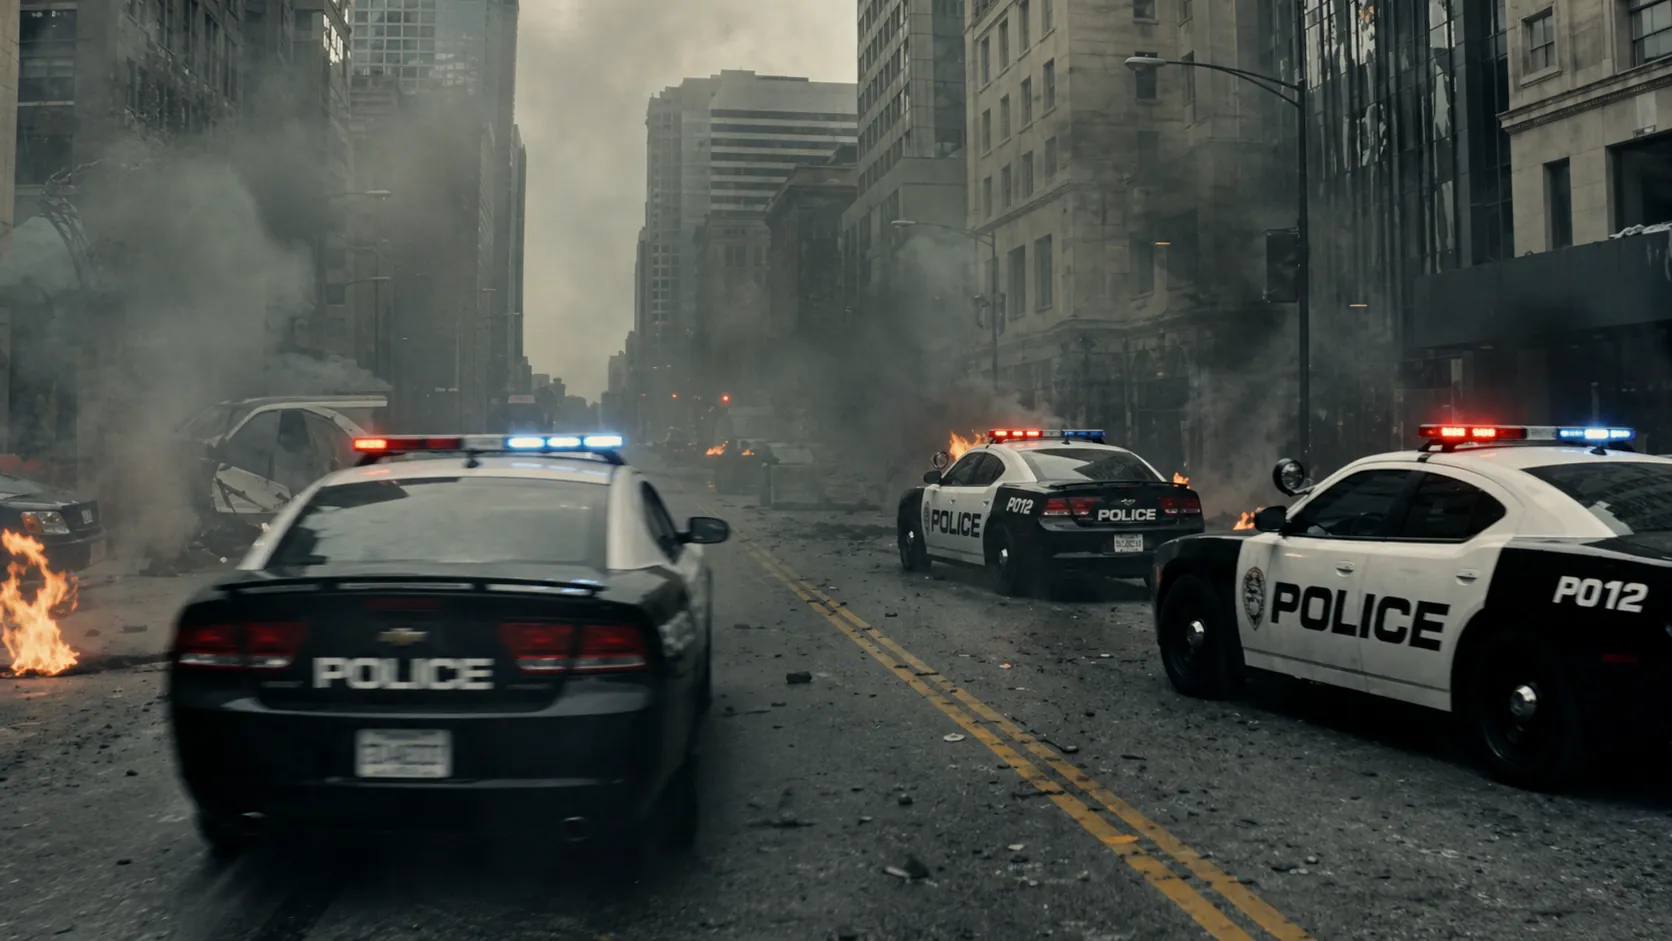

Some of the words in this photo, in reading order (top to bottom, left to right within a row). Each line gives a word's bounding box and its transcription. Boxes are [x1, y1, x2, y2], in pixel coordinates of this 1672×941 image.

[931, 509, 982, 538] POLICE
[1098, 508, 1156, 521] POLICE
[1270, 581, 1451, 652] POLICE
[312, 657, 495, 690] POLICE
